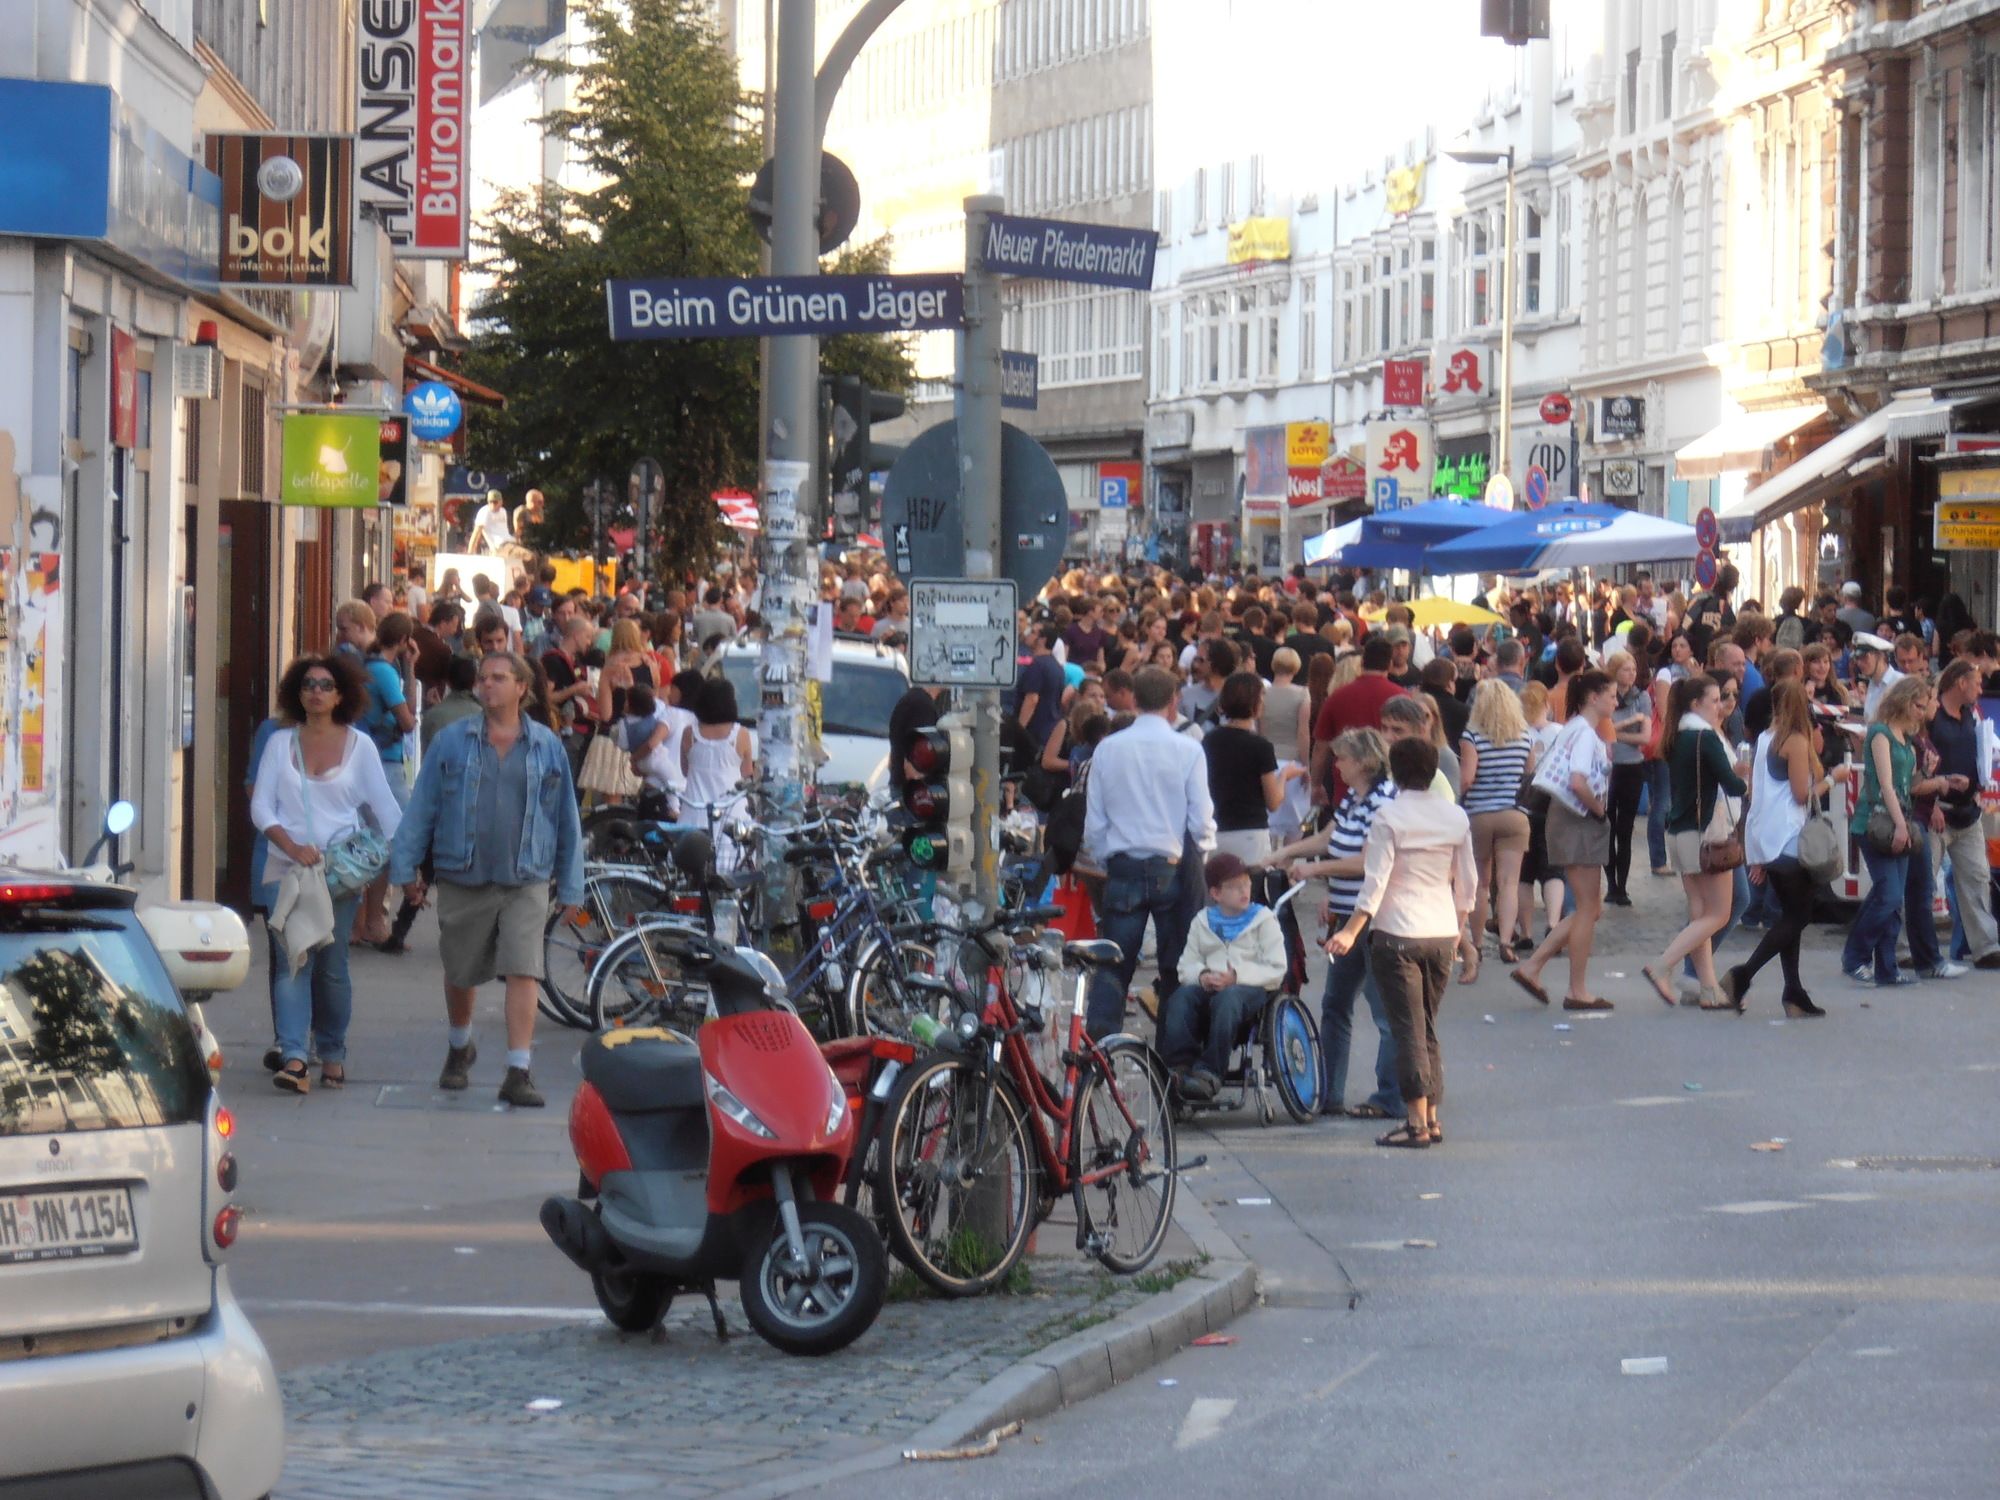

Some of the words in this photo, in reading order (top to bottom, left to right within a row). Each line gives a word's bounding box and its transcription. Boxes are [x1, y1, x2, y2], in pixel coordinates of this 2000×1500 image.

[229, 213, 331, 260] bok
[986, 222, 1038, 265] Neuer
[1041, 228, 1147, 278] Pferdemarkt
[228, 260, 273, 272] einfach
[629, 288, 716, 328] Beim
[728, 285, 848, 326] Grünen
[858, 281, 948, 329] Jäger
[412, 416, 450, 428] adidas
[1291, 446, 1324, 456] LOTTO
[0, 1201, 20, 1246] H
[34, 1197, 69, 1242] MN
[70, 1194, 130, 1240] 1154
